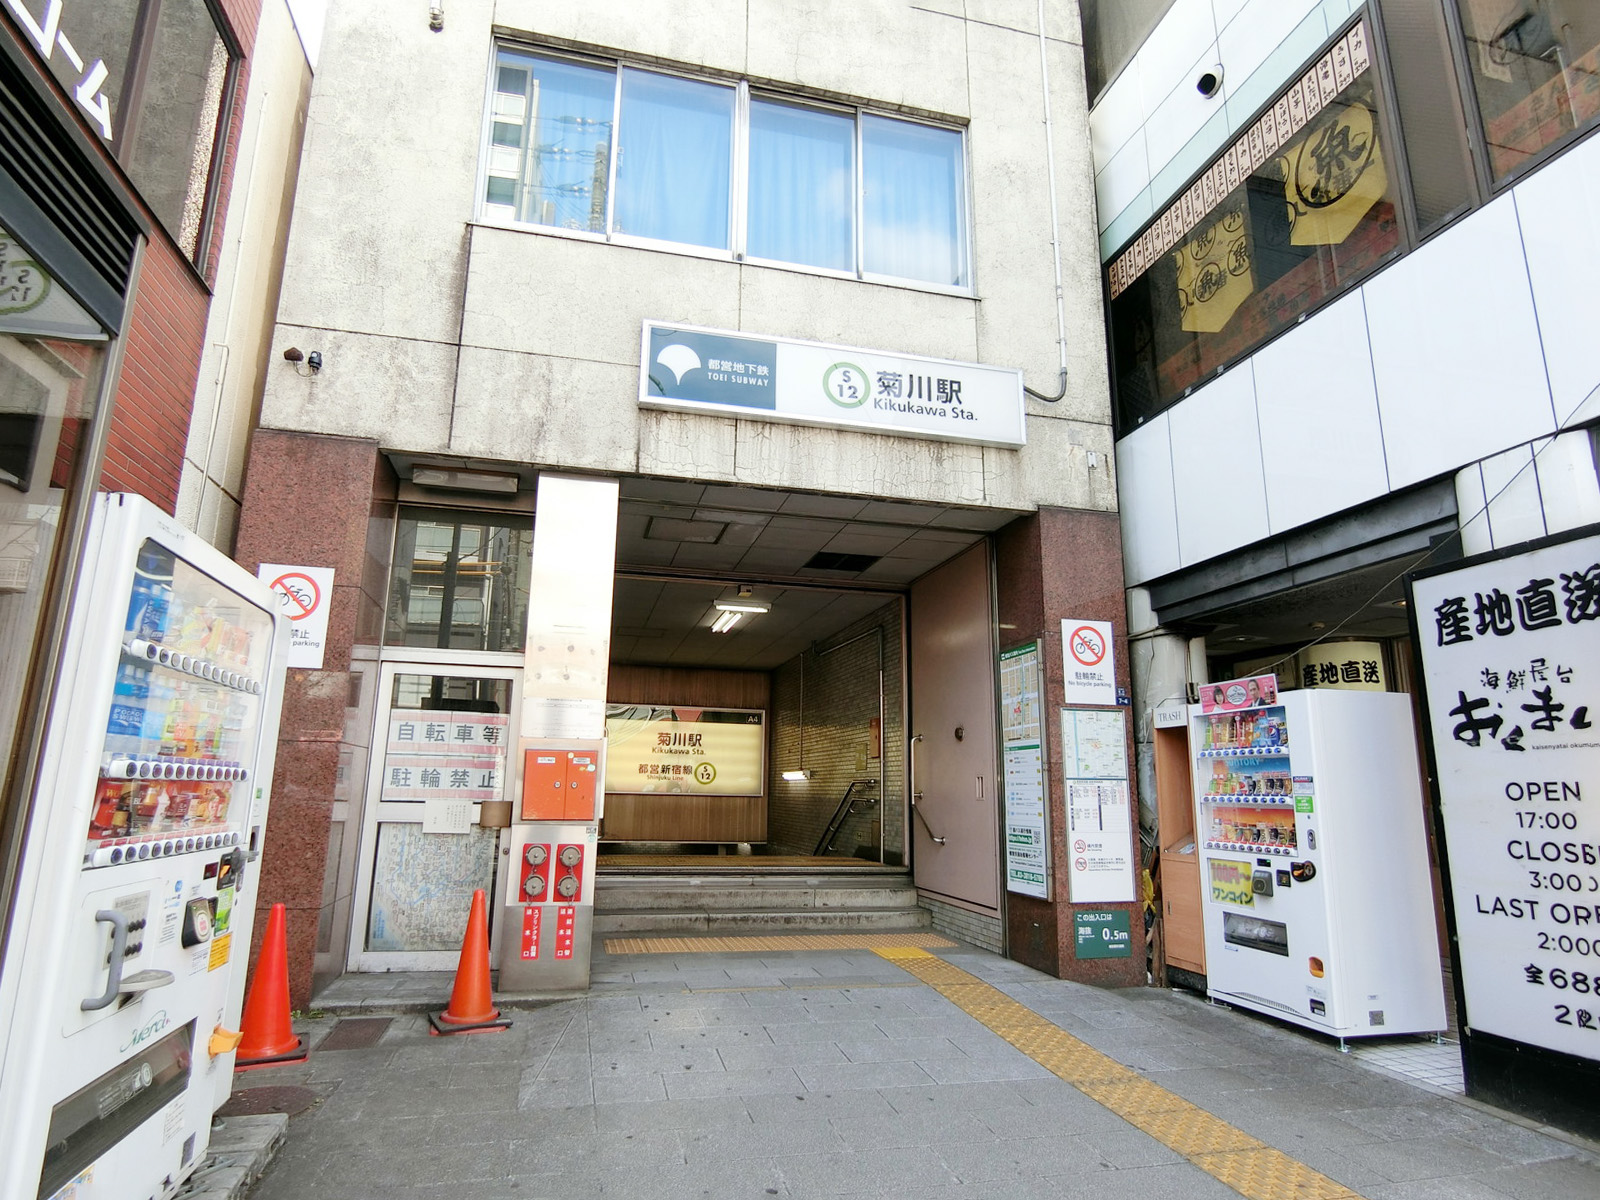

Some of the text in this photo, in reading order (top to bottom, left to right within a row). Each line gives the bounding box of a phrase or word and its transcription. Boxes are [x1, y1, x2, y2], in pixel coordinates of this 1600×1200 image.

[708, 359, 769, 376] 都営地下鉄
[708, 372, 769, 387] TOEI SUBWAY
[842, 370, 852, 383] S
[837, 384, 858, 399] 12
[876, 370, 963, 405] 菊川駅
[874, 398, 978, 421] Kikukawa Sta.
[292, 640, 320, 648] parking
[1303, 660, 1380, 688] 産地直送
[1480, 657, 1573, 694] 海鮮屋台
[1158, 710, 1182, 723] TRASH
[397, 721, 503, 745] 自転車等
[657, 732, 702, 747] 菊川駅
[651, 747, 706, 756] Kikukawa Sta.
[390, 767, 495, 789] 駐輪禁止
[638, 764, 693, 776] 都営新宿線
[700, 773, 711, 781] 12
[1505, 781, 1582, 802] OPEN
[1515, 811, 1578, 830] 17:00
[1212, 886, 1253, 905] ワンコイン
[1476, 894, 1539, 920] LAST
[1076, 912, 1113, 922] この出入口は
[1102, 927, 1129, 941] 0.5m
